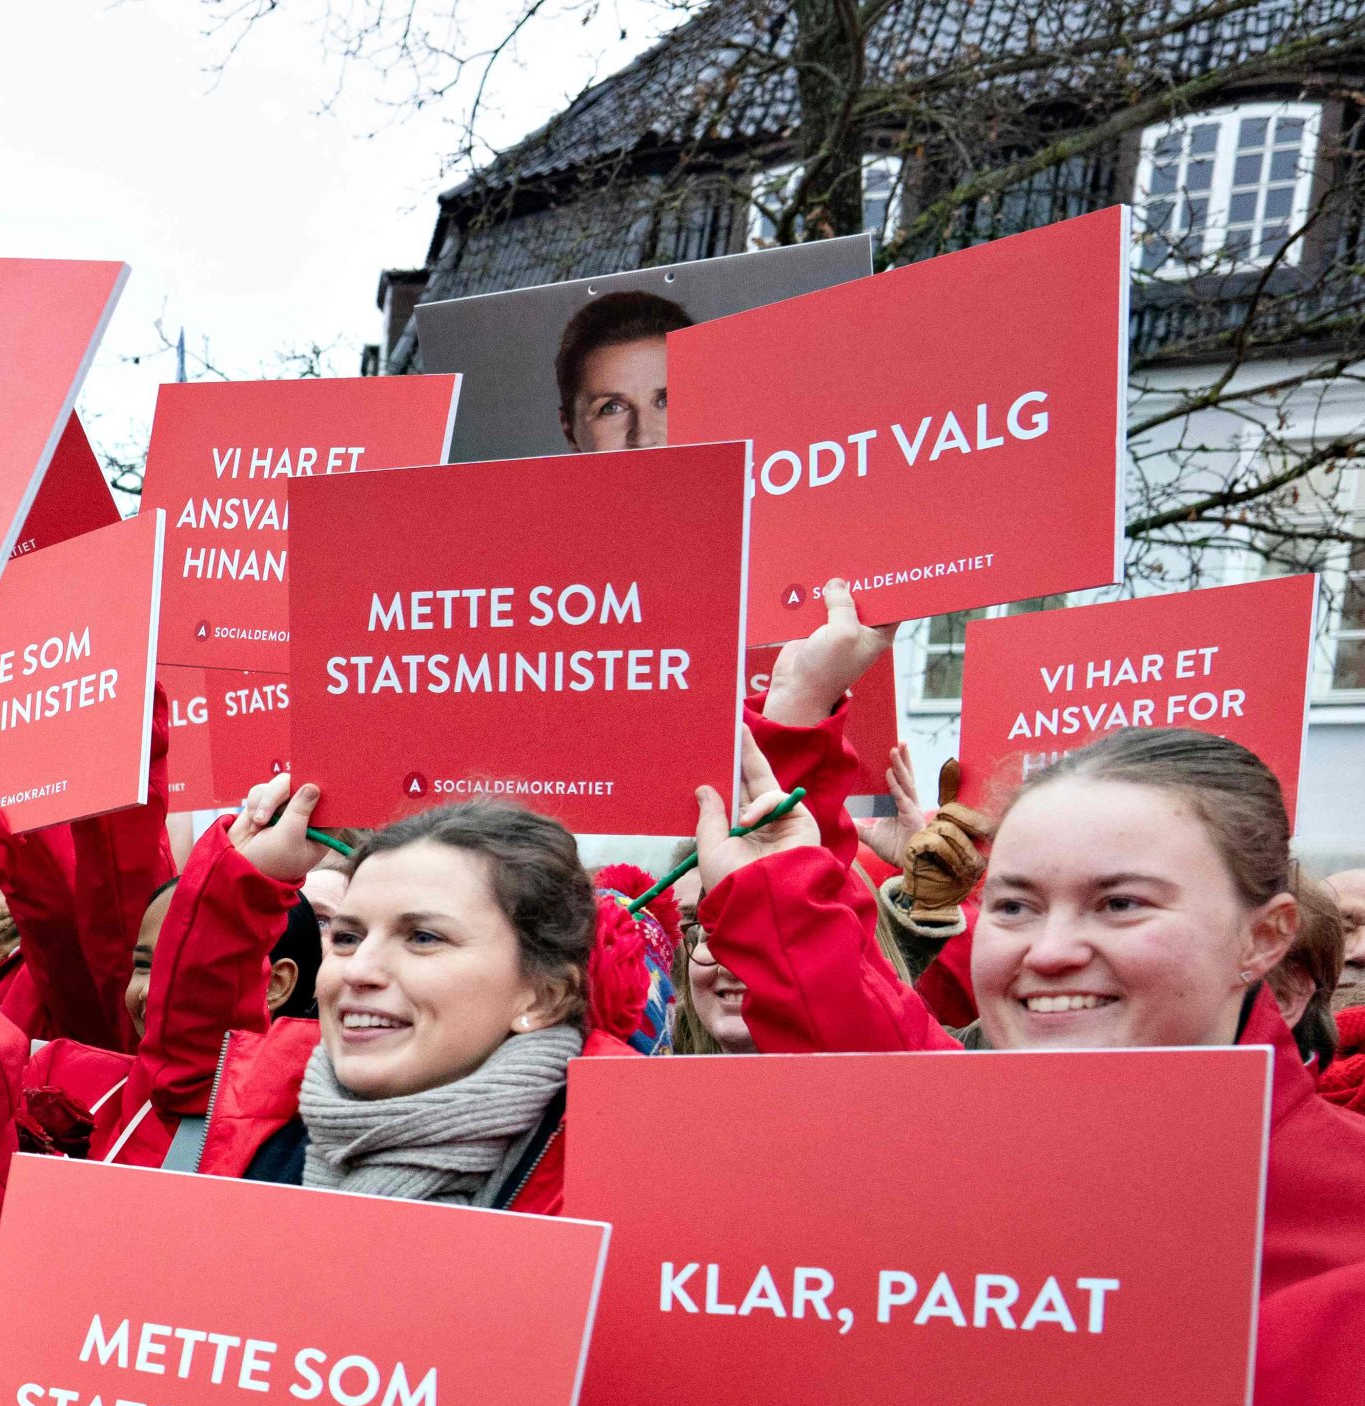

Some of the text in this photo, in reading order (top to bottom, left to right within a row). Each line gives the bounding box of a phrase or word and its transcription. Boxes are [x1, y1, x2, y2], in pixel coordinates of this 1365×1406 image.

[212, 447, 242, 479] VI
[249, 447, 317, 478] HAR
[750, 390, 1049, 499] ODT VALG
[182, 547, 288, 582] HINAN
[812, 553, 994, 600] SIALDEMOKRATIET
[367, 581, 642, 632] METTE SOM
[22, 626, 91, 676] SOM
[214, 627, 290, 642] SOCIALDEMO
[326, 648, 691, 695] STATSMINISTER
[1040, 647, 1219, 694] VI HAR ET
[1008, 689, 1246, 740] ANSVAR FOR
[434, 779, 614, 795] SOCIALDEMOKRATIET
[659, 1261, 1120, 1335] KLAR, PARAT
[78, 1313, 277, 1392] METTE
